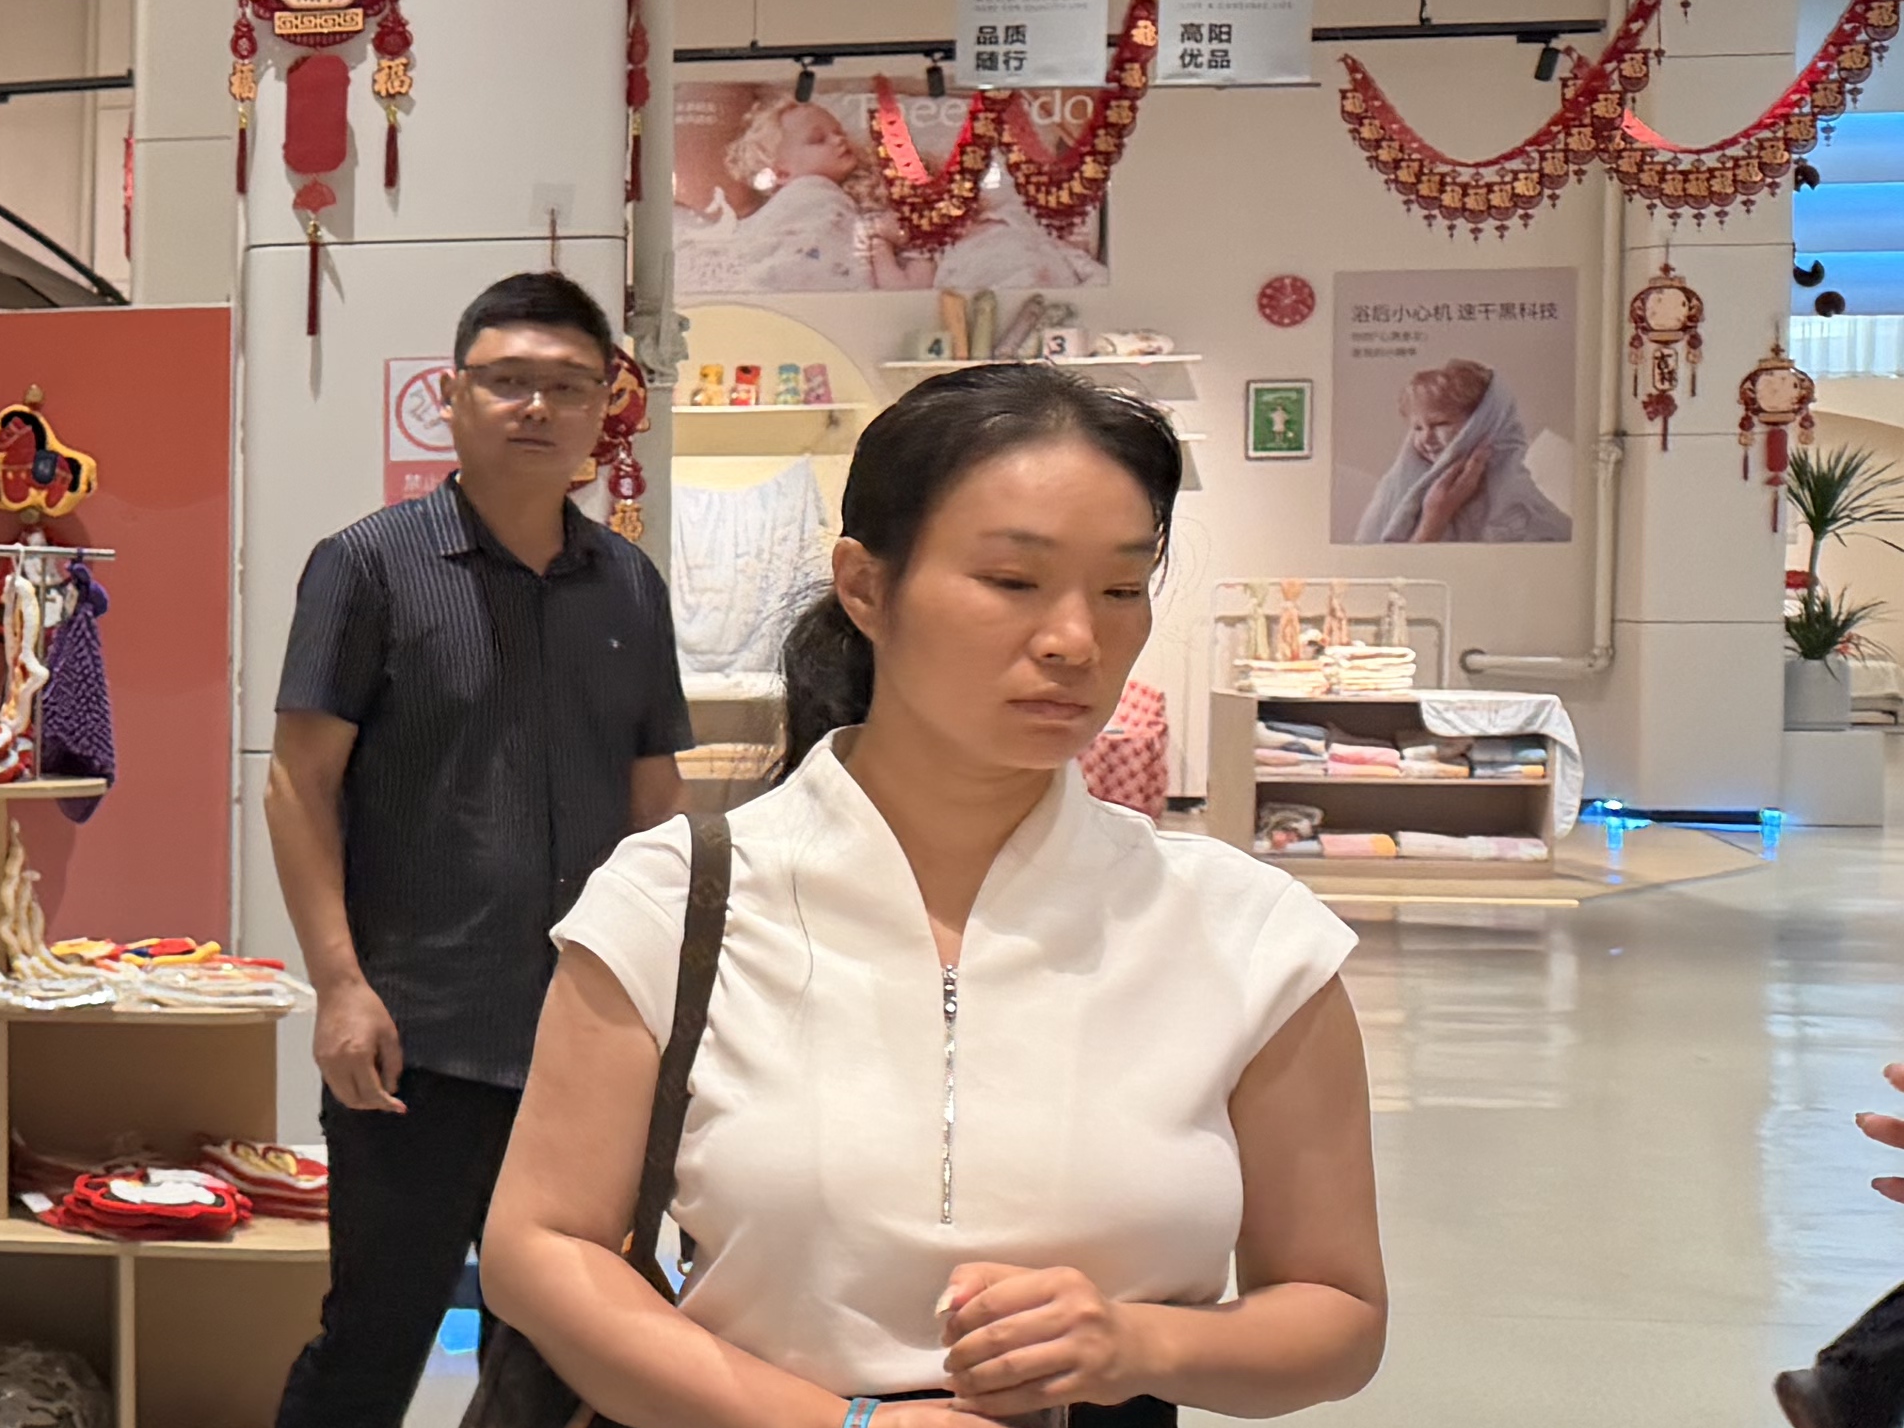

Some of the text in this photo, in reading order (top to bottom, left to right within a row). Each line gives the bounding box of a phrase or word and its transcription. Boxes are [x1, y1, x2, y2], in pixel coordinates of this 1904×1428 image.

[976, 24, 1027, 46] 品质
[1179, 22, 1233, 44] 高阳
[975, 50, 1027, 72] 随行
[1179, 48, 1232, 70] 优品
